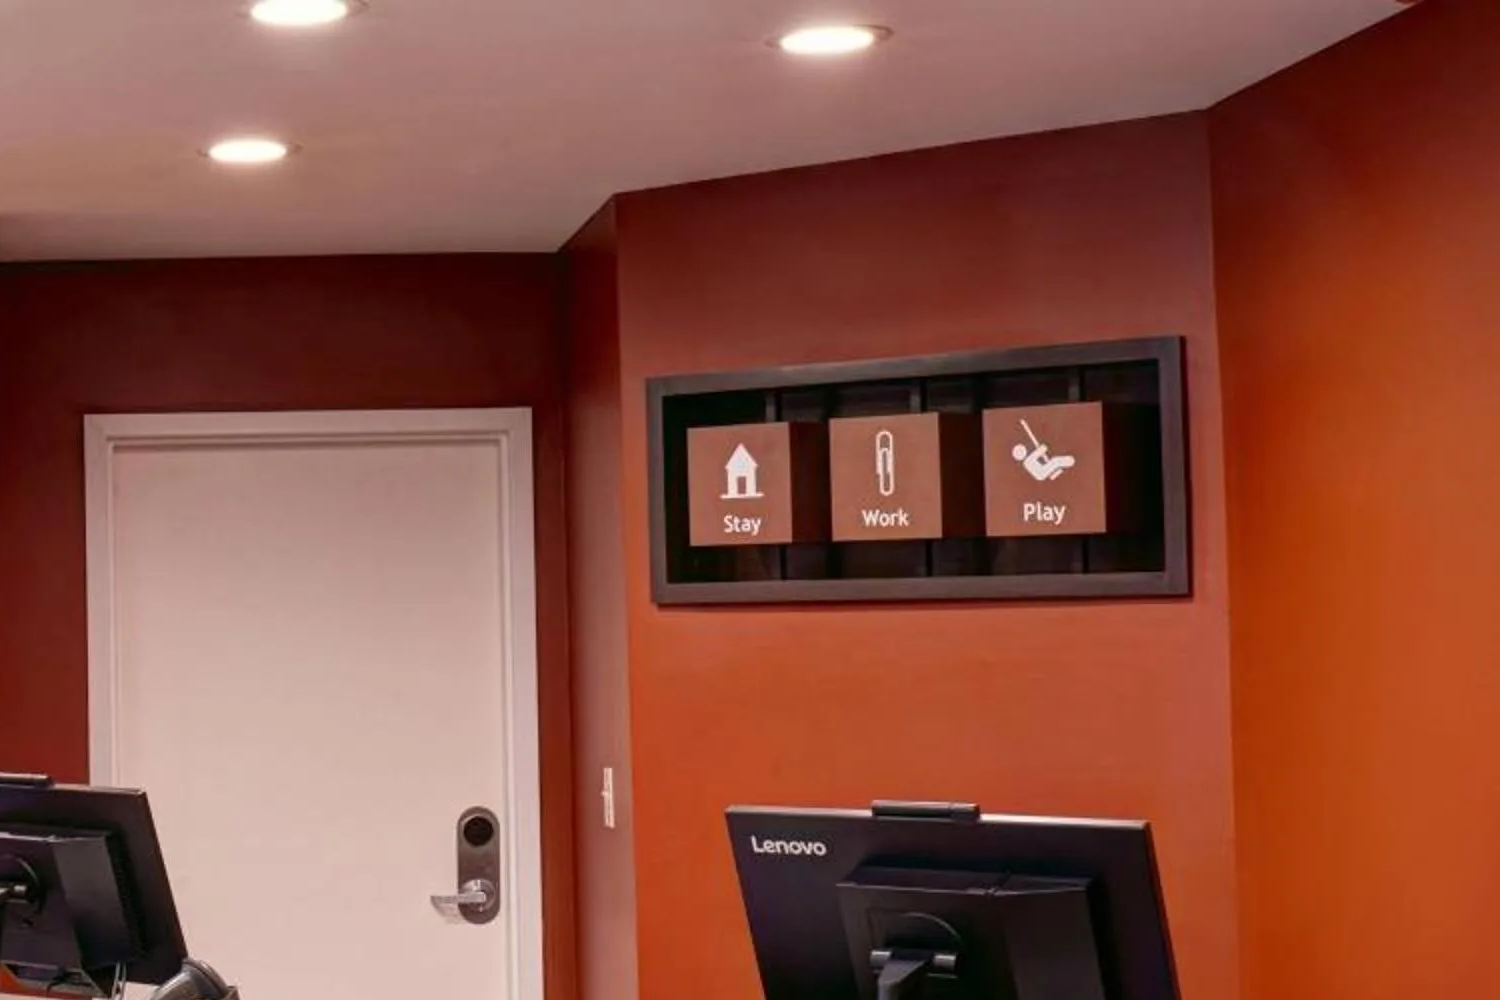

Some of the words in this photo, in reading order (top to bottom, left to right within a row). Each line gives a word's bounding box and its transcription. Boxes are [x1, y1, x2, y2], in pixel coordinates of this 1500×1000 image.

[862, 508, 910, 527] Work
[1023, 501, 1066, 525] Play
[723, 514, 762, 536] Stay
[750, 835, 827, 857] Lenovo
